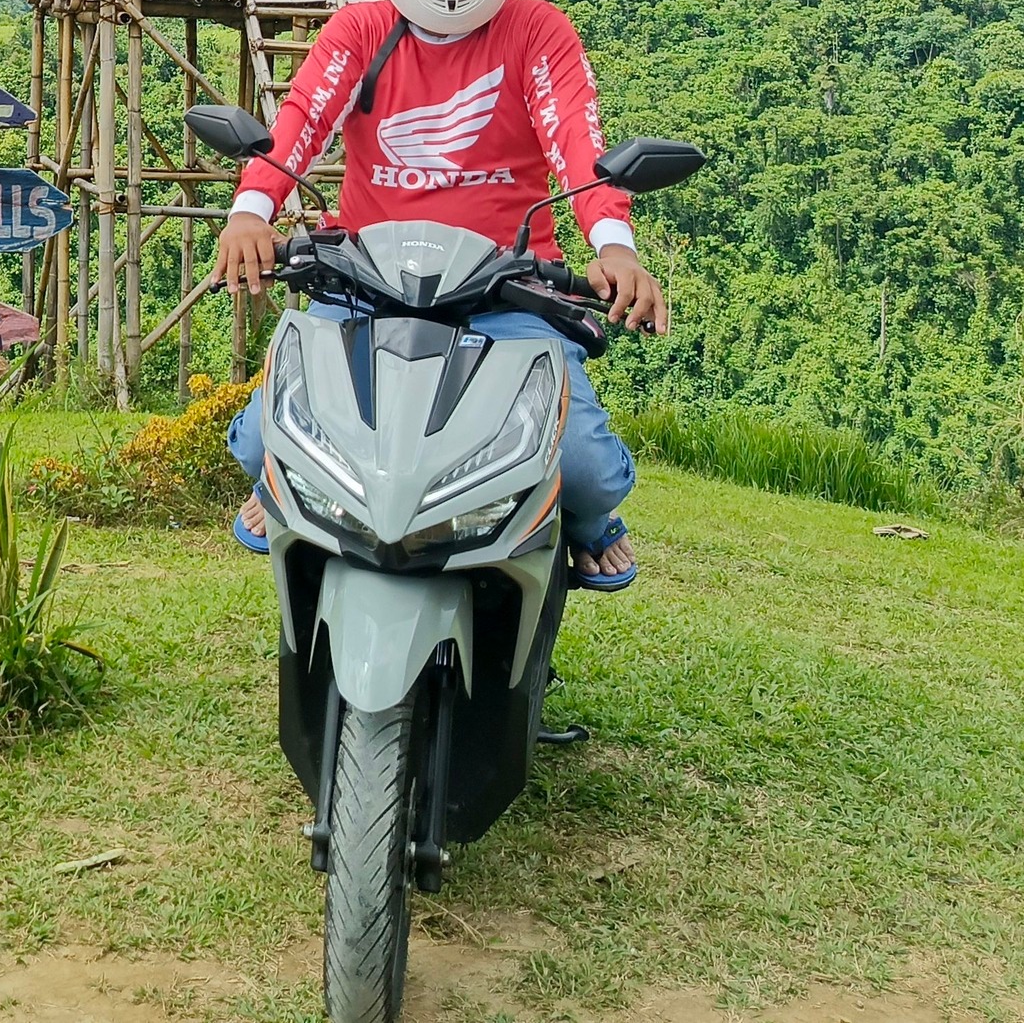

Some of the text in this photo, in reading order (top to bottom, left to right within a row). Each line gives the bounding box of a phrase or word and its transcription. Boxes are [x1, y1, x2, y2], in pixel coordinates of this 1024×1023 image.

[323, 49, 351, 86] INC.
[371, 164, 516, 190] HONDA
[401, 240, 445, 252] HONDA
